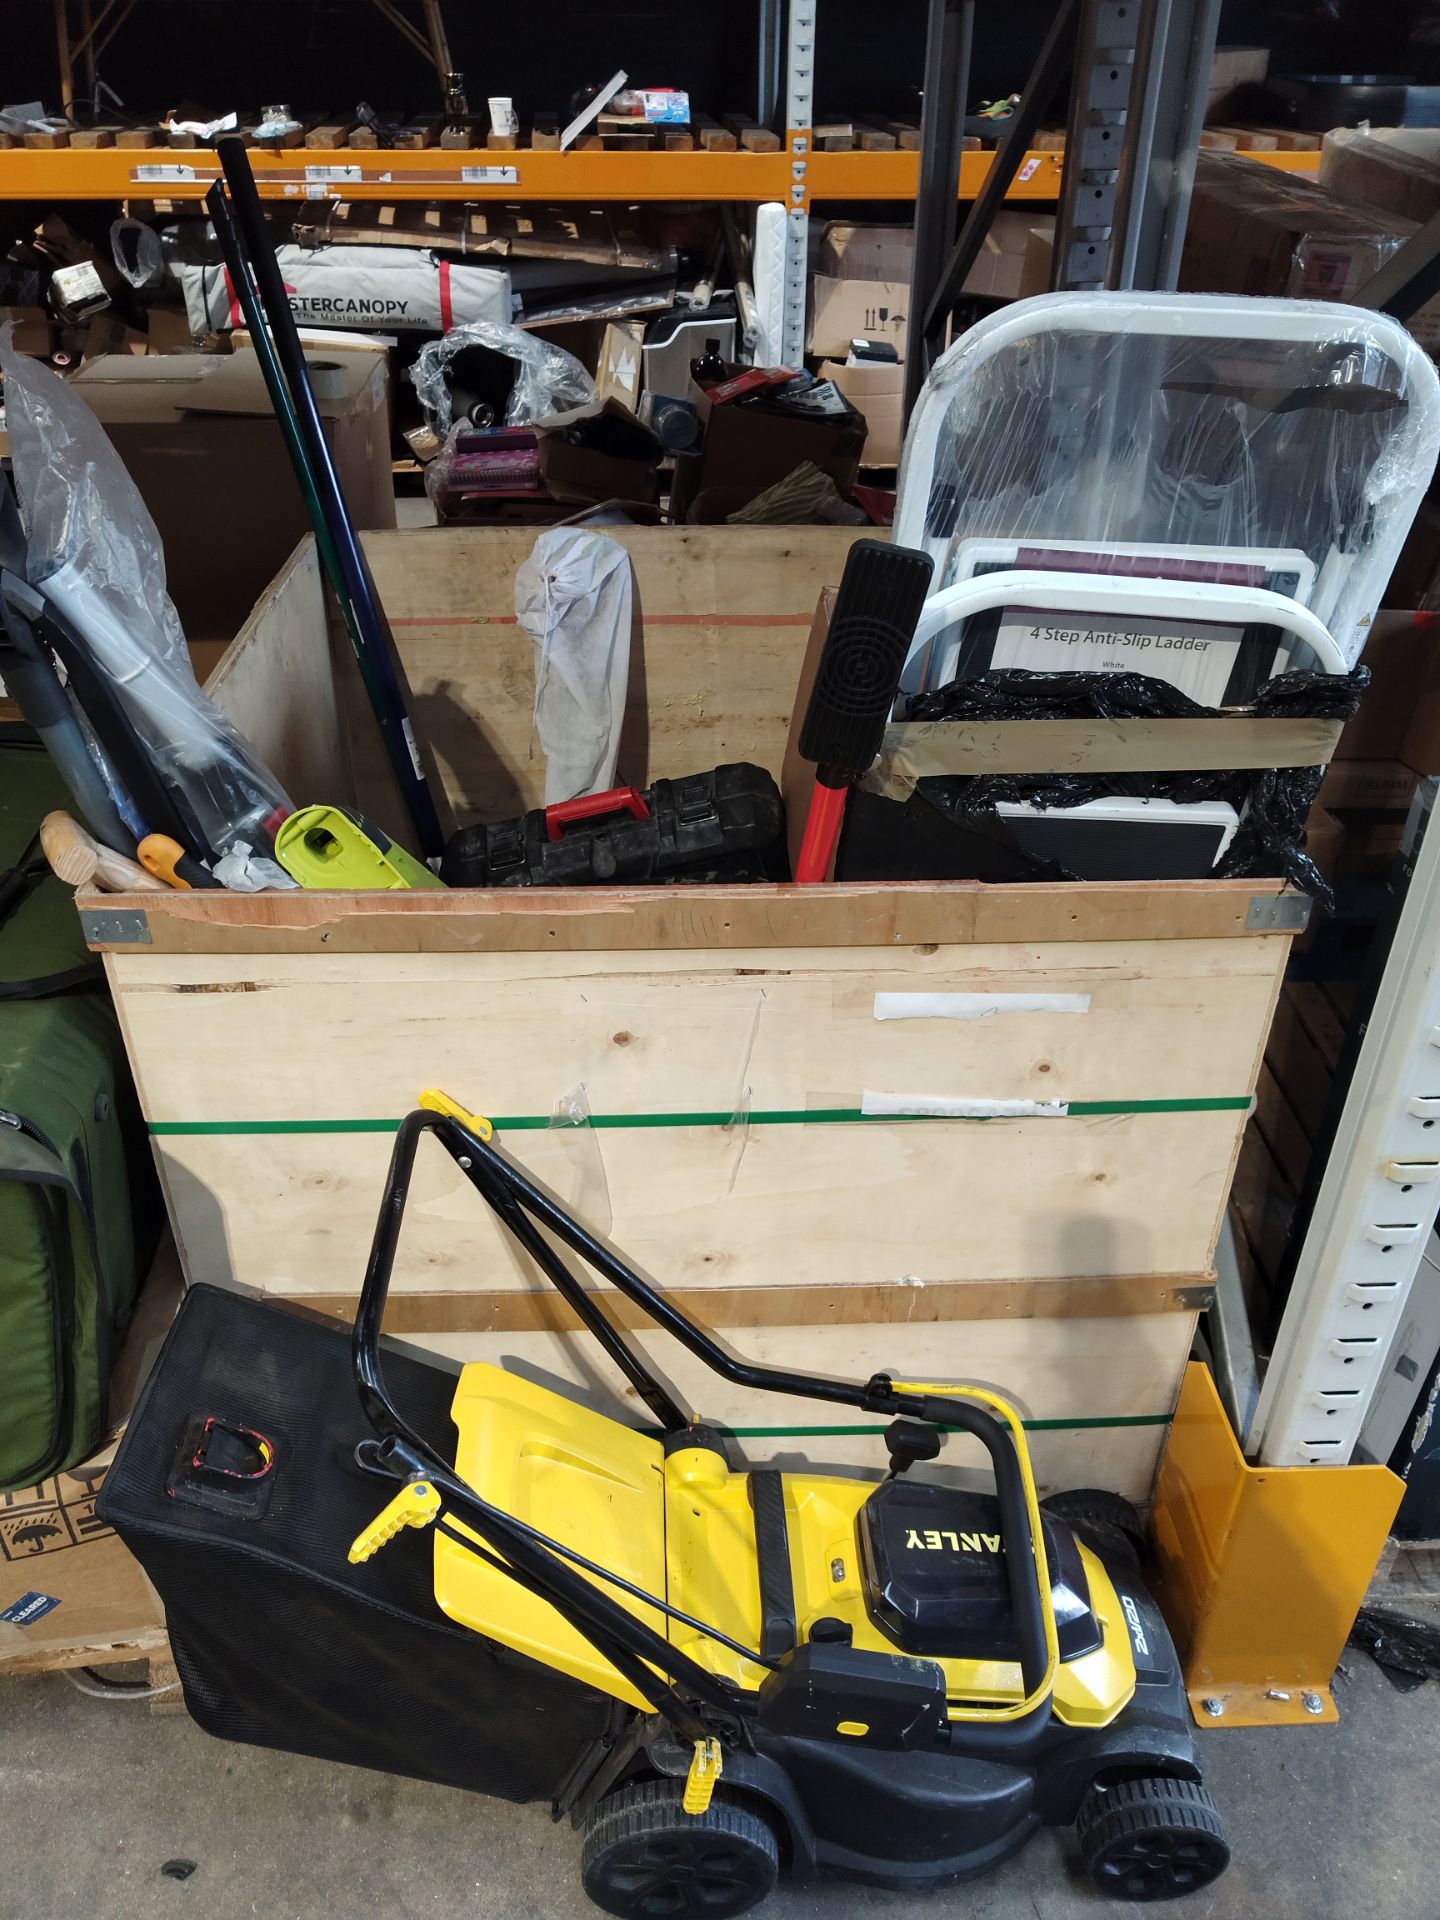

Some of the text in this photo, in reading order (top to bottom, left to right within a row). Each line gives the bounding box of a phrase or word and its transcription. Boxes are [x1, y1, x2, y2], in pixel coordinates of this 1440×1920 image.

[1030, 627, 1211, 652] 4 Step Anti-Slip Ladder
[1102, 661, 1125, 669] White
[906, 1529, 1034, 1554] ANLEY
[11, 1596, 48, 1622] CLEARED
